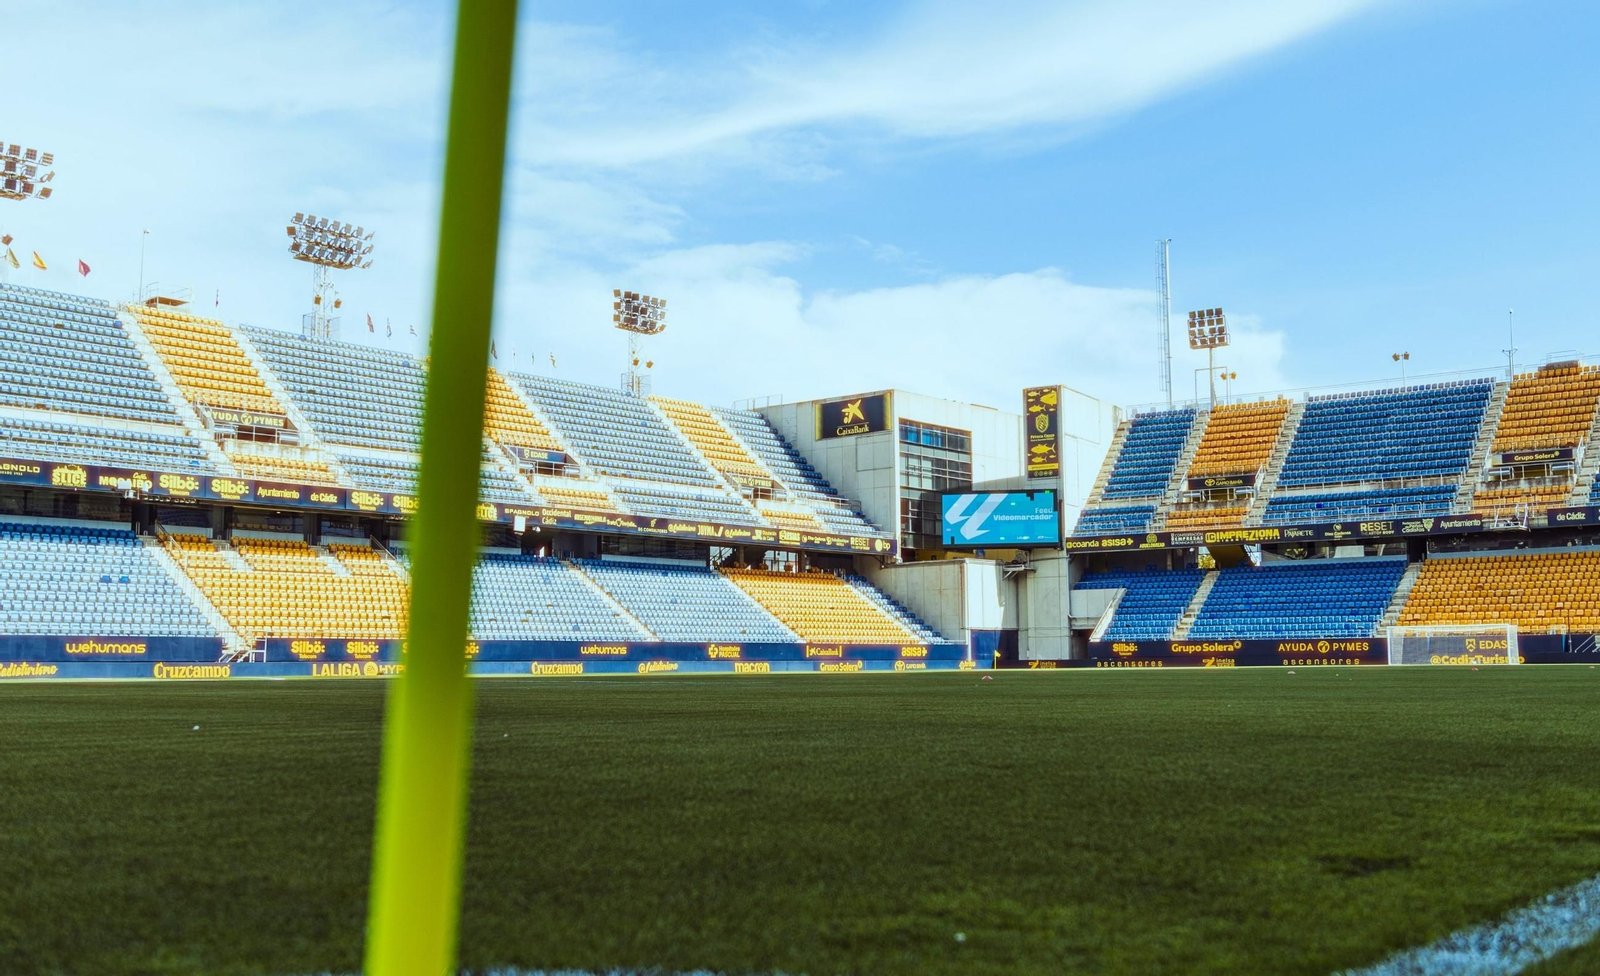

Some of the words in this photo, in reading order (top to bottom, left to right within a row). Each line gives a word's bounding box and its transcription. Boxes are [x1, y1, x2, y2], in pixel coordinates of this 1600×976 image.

[206, 410, 239, 422] YUDA
[253, 415, 284, 427] PYMES
[836, 424, 870, 436] CaixaBank
[52, 471, 87, 485] SLICE
[257, 486, 300, 499] Ayuntamiento
[310, 492, 319, 501] de
[504, 508, 540, 516] SPAGNOLO
[541, 508, 571, 518] Occidental
[1359, 520, 1394, 532] RESET
[1440, 519, 1481, 529] Ayuntamiento
[1556, 513, 1566, 521] de
[1566, 512, 1586, 520] Cádiz
[1216, 529, 1280, 541] IMPREZIONA
[850, 537, 870, 546] RESET
[882, 540, 891, 551] bp
[1072, 540, 1099, 548] coanda
[1101, 538, 1127, 547] asisa
[65, 640, 146, 654] wehumans
[580, 644, 627, 655] wehumans
[901, 646, 922, 657] asisa
[1171, 643, 1202, 654] Grupo
[1202, 642, 1234, 652] Solera
[1278, 642, 1314, 652] AYUDA
[1332, 642, 1369, 651] PYMES
[734, 662, 770, 673] macron
[820, 662, 839, 672] Grupo
[839, 662, 858, 672] Solera
[1097, 660, 1163, 668] ascensores
[1283, 658, 1360, 666] ascensores
[153, 662, 231, 679] Cruzcampo
[312, 663, 361, 677] LALIGA
[531, 661, 583, 675] Cruzcampo
